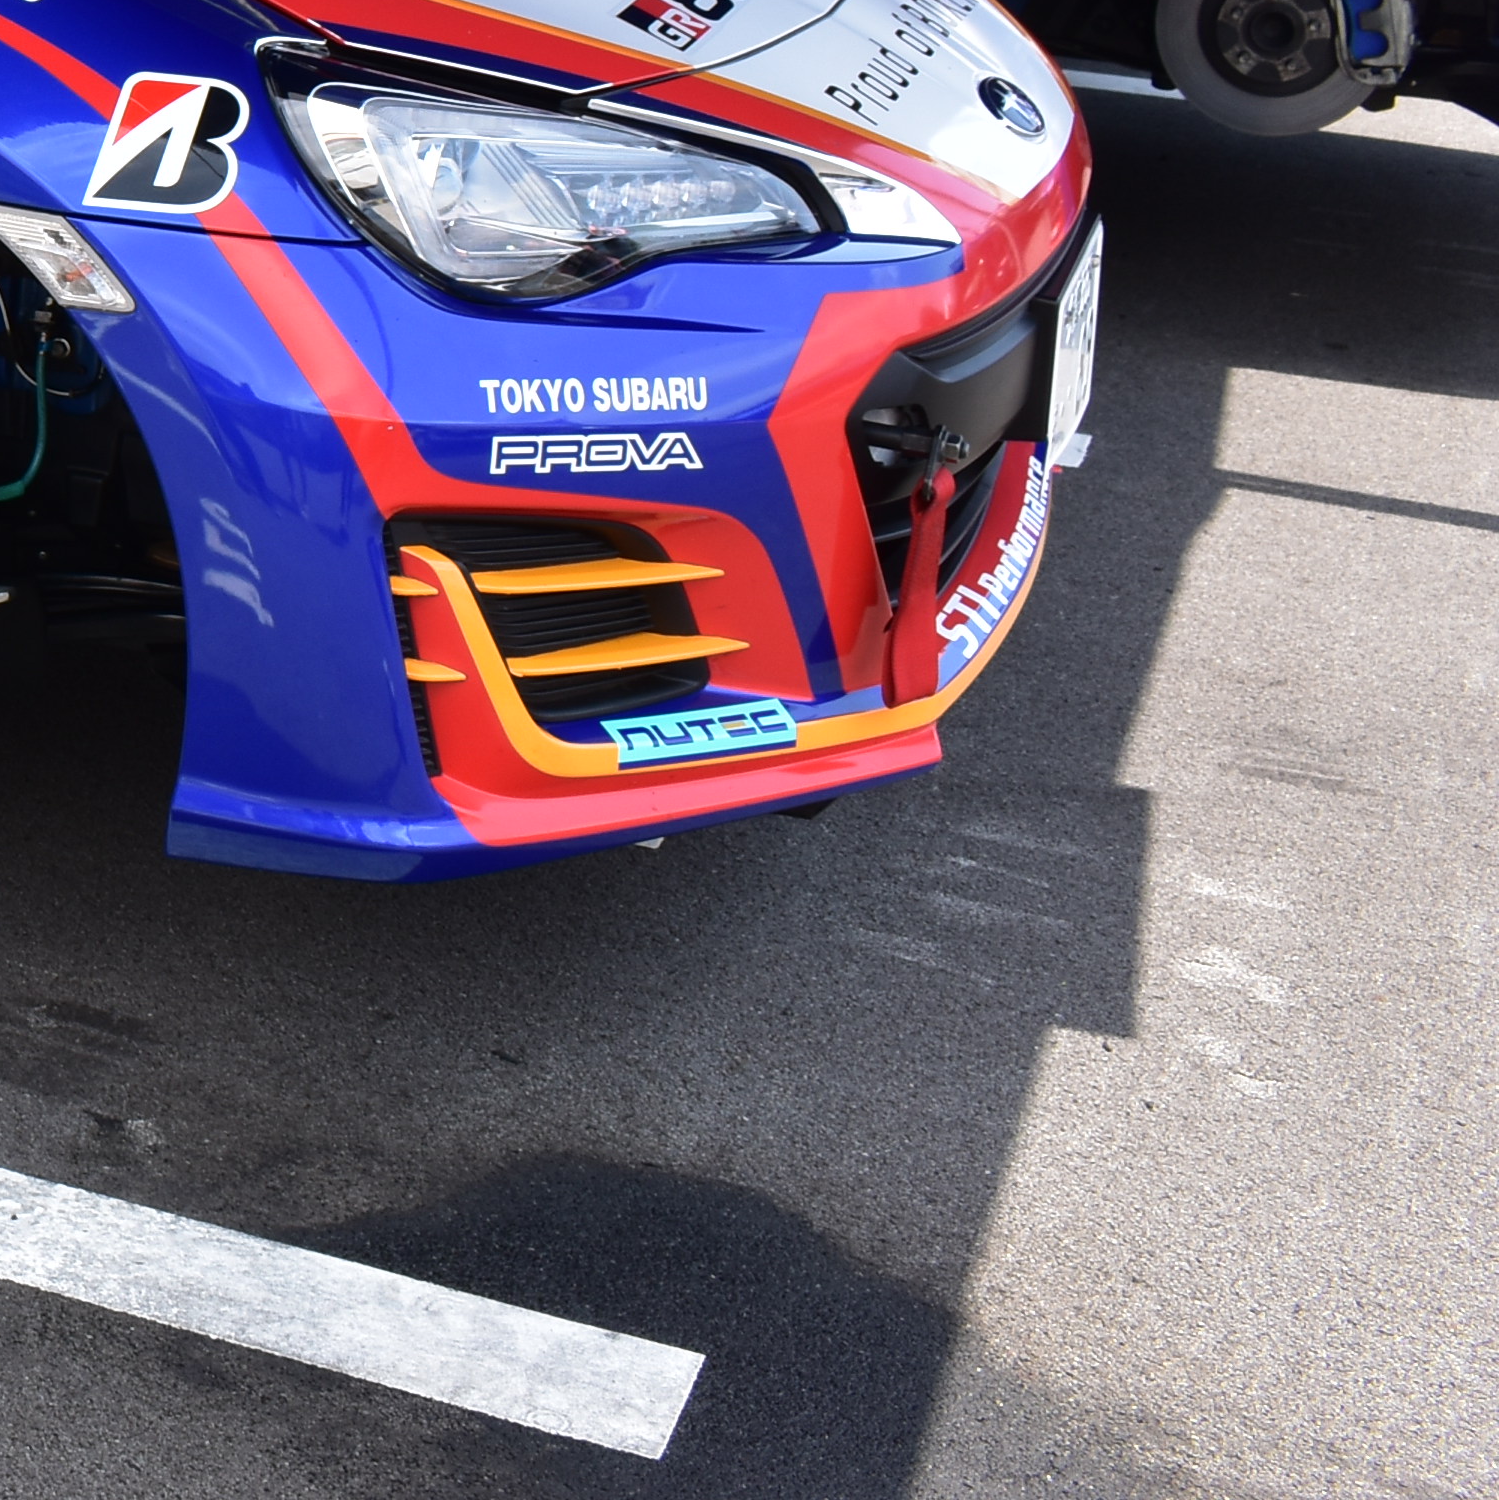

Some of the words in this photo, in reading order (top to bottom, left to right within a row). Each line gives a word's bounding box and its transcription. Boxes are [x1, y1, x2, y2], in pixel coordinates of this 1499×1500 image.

[648, 8, 711, 52] GR
[824, 37, 920, 126] Proud
[891, 12, 940, 57] of
[480, 378, 584, 414] TOKYO
[593, 376, 708, 412] SUBARU
[489, 432, 704, 475] PROVA
[935, 582, 1000, 660] STI
